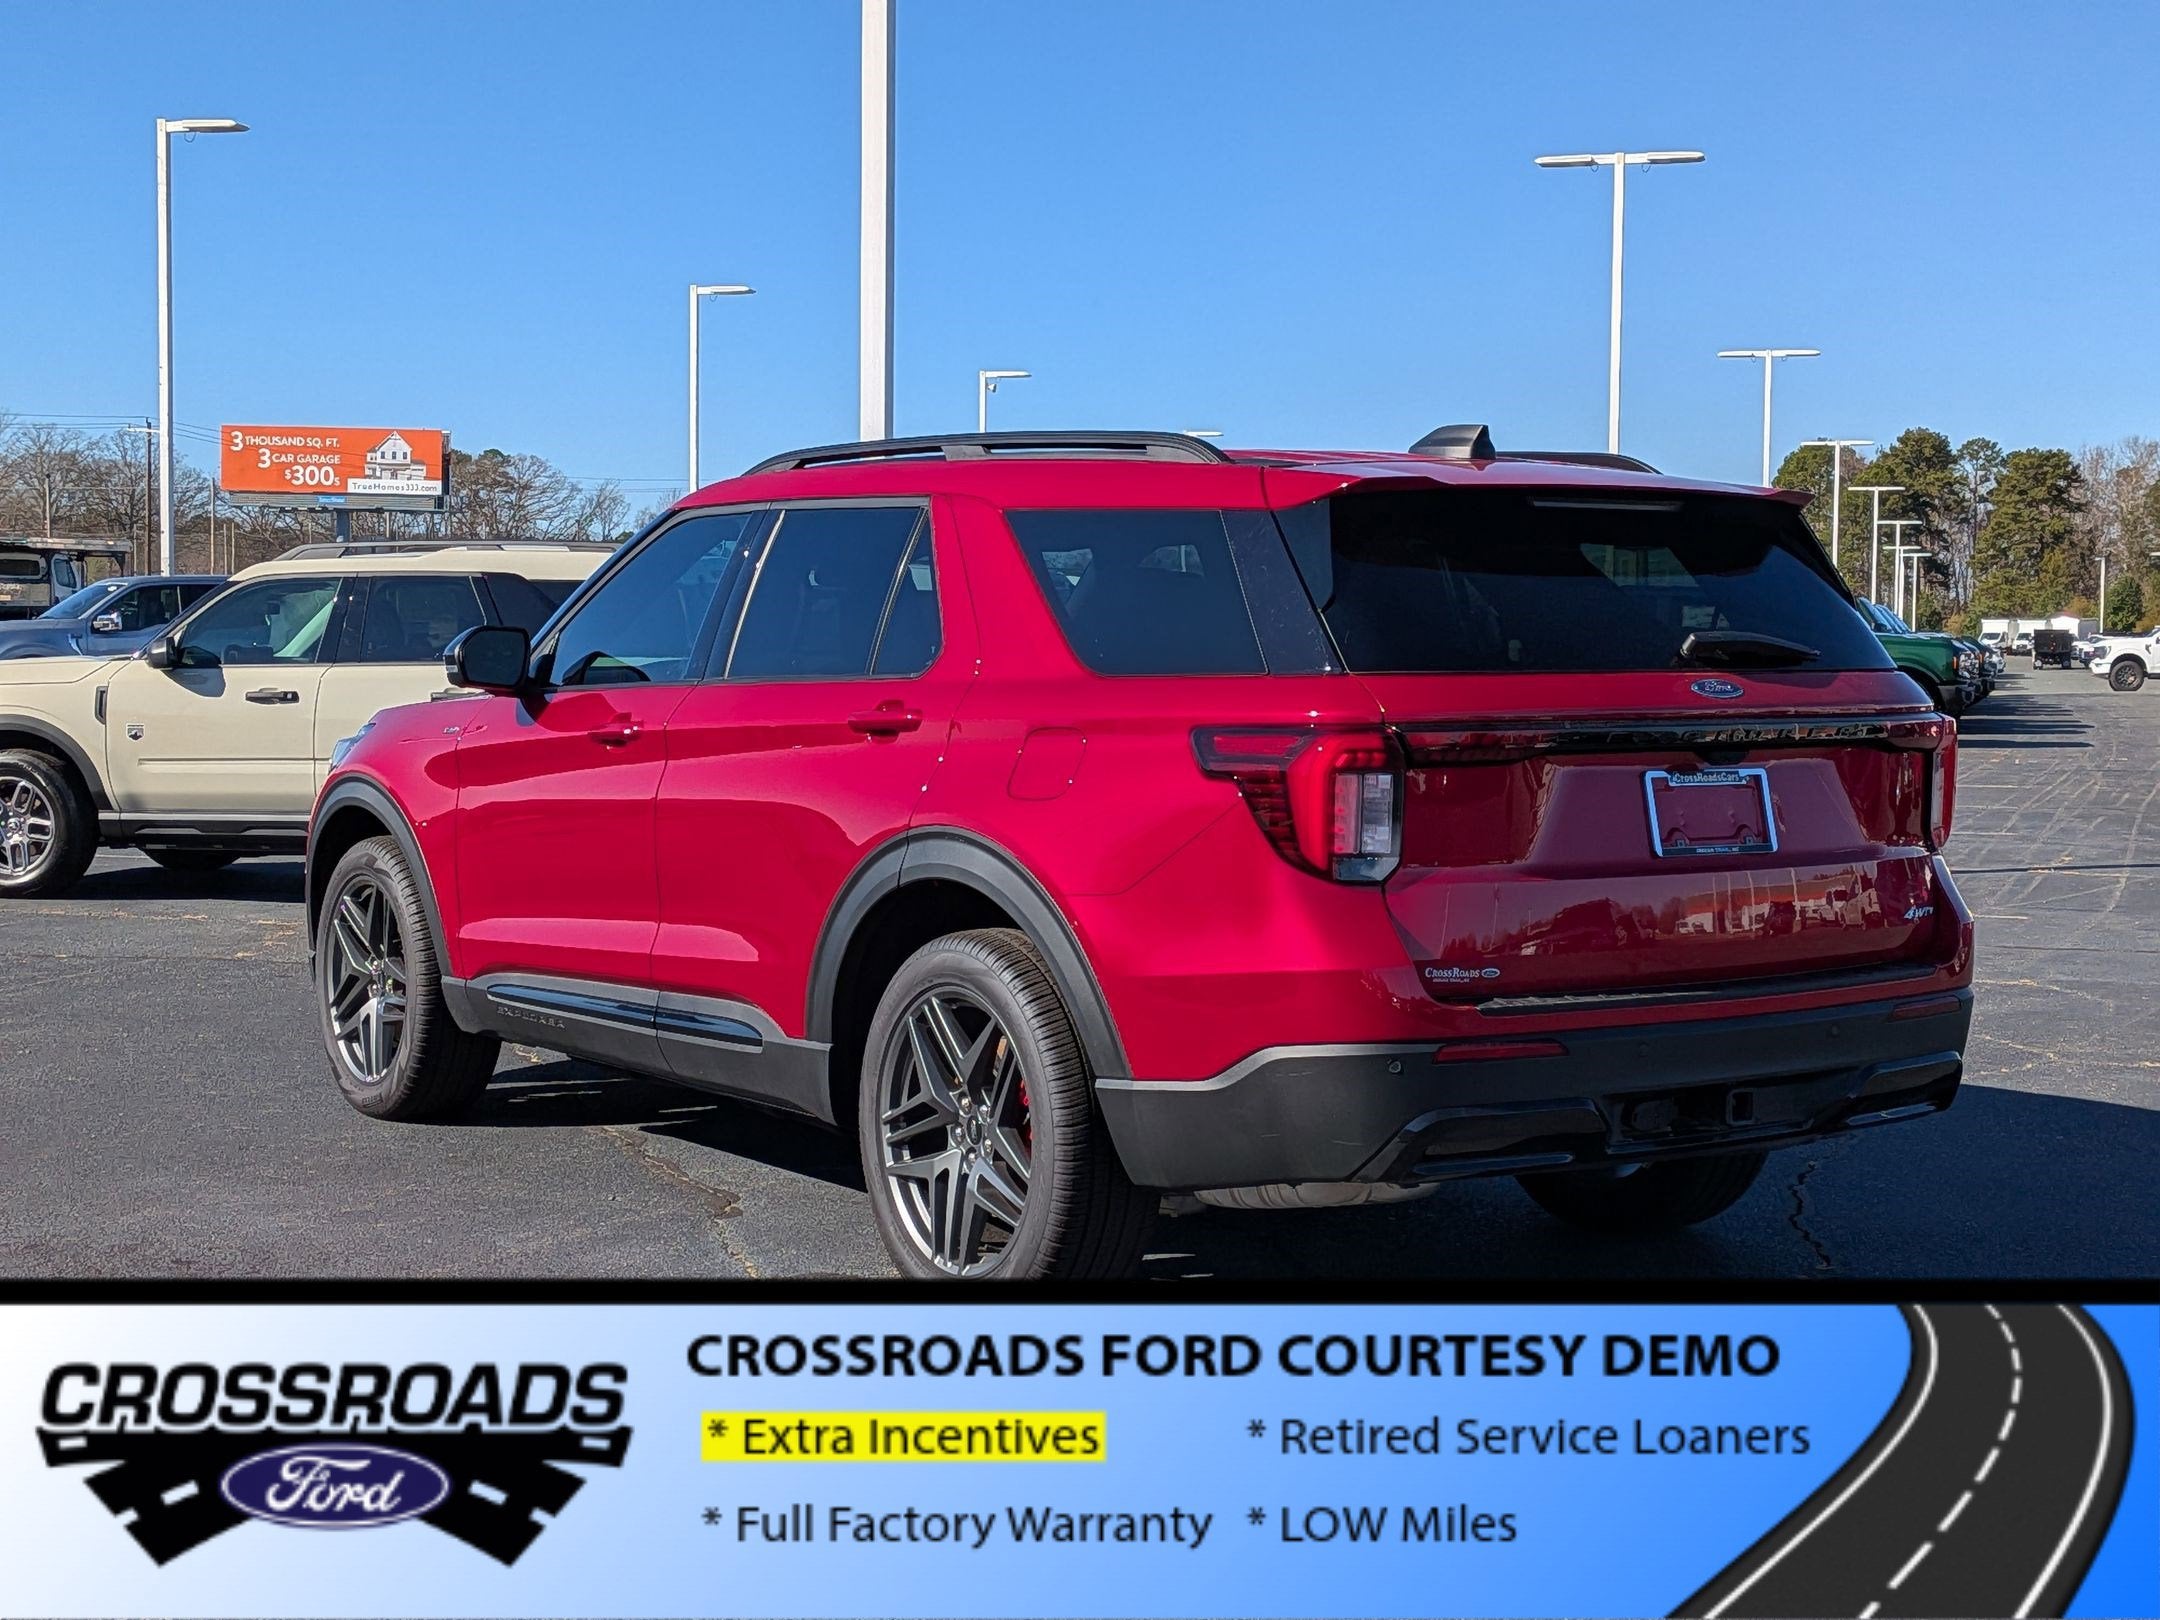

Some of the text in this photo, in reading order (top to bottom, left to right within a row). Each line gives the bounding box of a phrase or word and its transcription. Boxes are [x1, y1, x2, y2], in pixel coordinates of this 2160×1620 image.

[230, 431, 340, 451] 3 THOUSAND SQ. FT.
[258, 448, 341, 468] 3 CAR GARAGE
[352, 482, 437, 492] TrueHomes333.com
